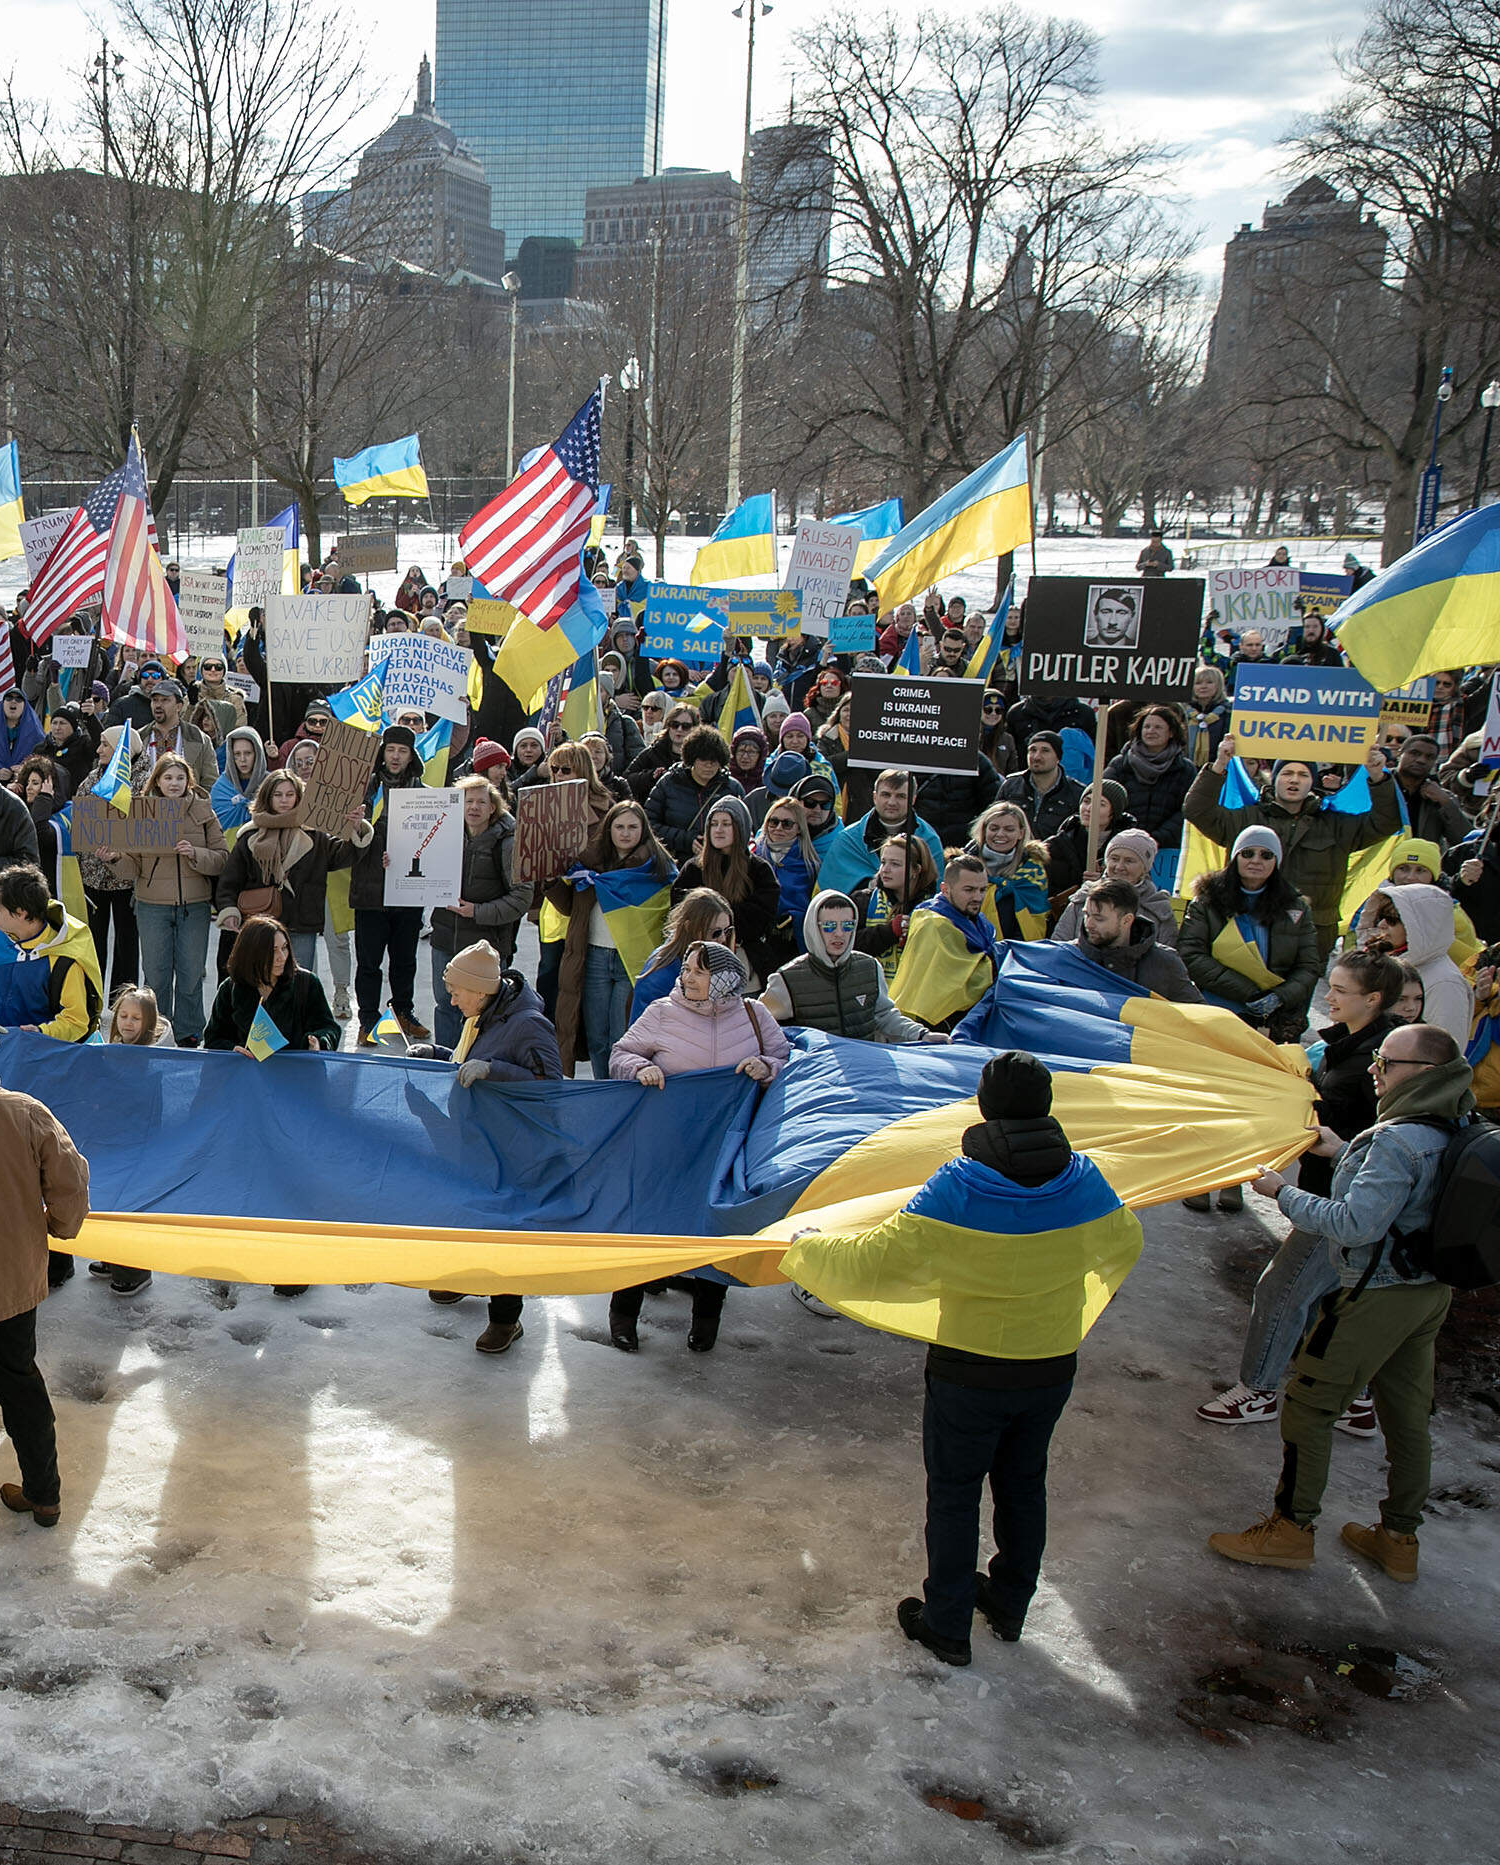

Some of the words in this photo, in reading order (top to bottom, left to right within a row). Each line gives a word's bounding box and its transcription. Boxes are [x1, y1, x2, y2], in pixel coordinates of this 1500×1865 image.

[30, 513, 73, 534] TRUMP
[801, 527, 852, 550] RUSSIA
[796, 549, 850, 573] INVADED
[796, 575, 845, 598] UKRAINE
[1214, 569, 1297, 592] SUPPORT
[649, 585, 710, 601] UKRAINE
[728, 591, 778, 602] SUPPORT
[1300, 593, 1344, 608] KRAIN
[282, 599, 337, 622] WAKE
[648, 612, 661, 623] IS
[1211, 590, 1301, 626] UKRAINE
[271, 628, 322, 651] SAVE
[330, 628, 365, 653] USA
[371, 637, 431, 650] UKRAINE
[432, 642, 465, 663] GAVE
[644, 636, 674, 650] FOR
[271, 656, 306, 675] SAVE
[370, 650, 388, 661] UP
[390, 648, 410, 658] ITS
[412, 649, 469, 677] NUCLEAR
[372, 658, 435, 674] SENAL!
[1028, 652, 1119, 684] PUTLER
[1125, 656, 1196, 687] KAPUT
[384, 683, 436, 699] TRAYED
[385, 672, 400, 683] HY
[403, 673, 430, 687] USA
[431, 676, 454, 696] HAS
[892, 687, 931, 699] CRIMEA
[382, 694, 433, 709] RAINE?
[1238, 685, 1311, 704] STAND
[1317, 689, 1375, 707] WITH
[883, 701, 893, 711] IS
[895, 702, 941, 715] UKRAINE!
[1382, 701, 1430, 714] RAINI
[880, 716, 939, 730] SURRENDER
[1238, 719, 1366, 745] UKRAINE
[858, 729, 899, 742] DOESN'T
[900, 733, 930, 745] MEAN
[931, 736, 967, 748] PEACE!
[311, 747, 370, 796] RUSSIA
[315, 781, 356, 814] TRICK
[80, 819, 116, 847] NOT
[125, 818, 183, 848] UKRAINE
[520, 848, 579, 883] CHILDRE
